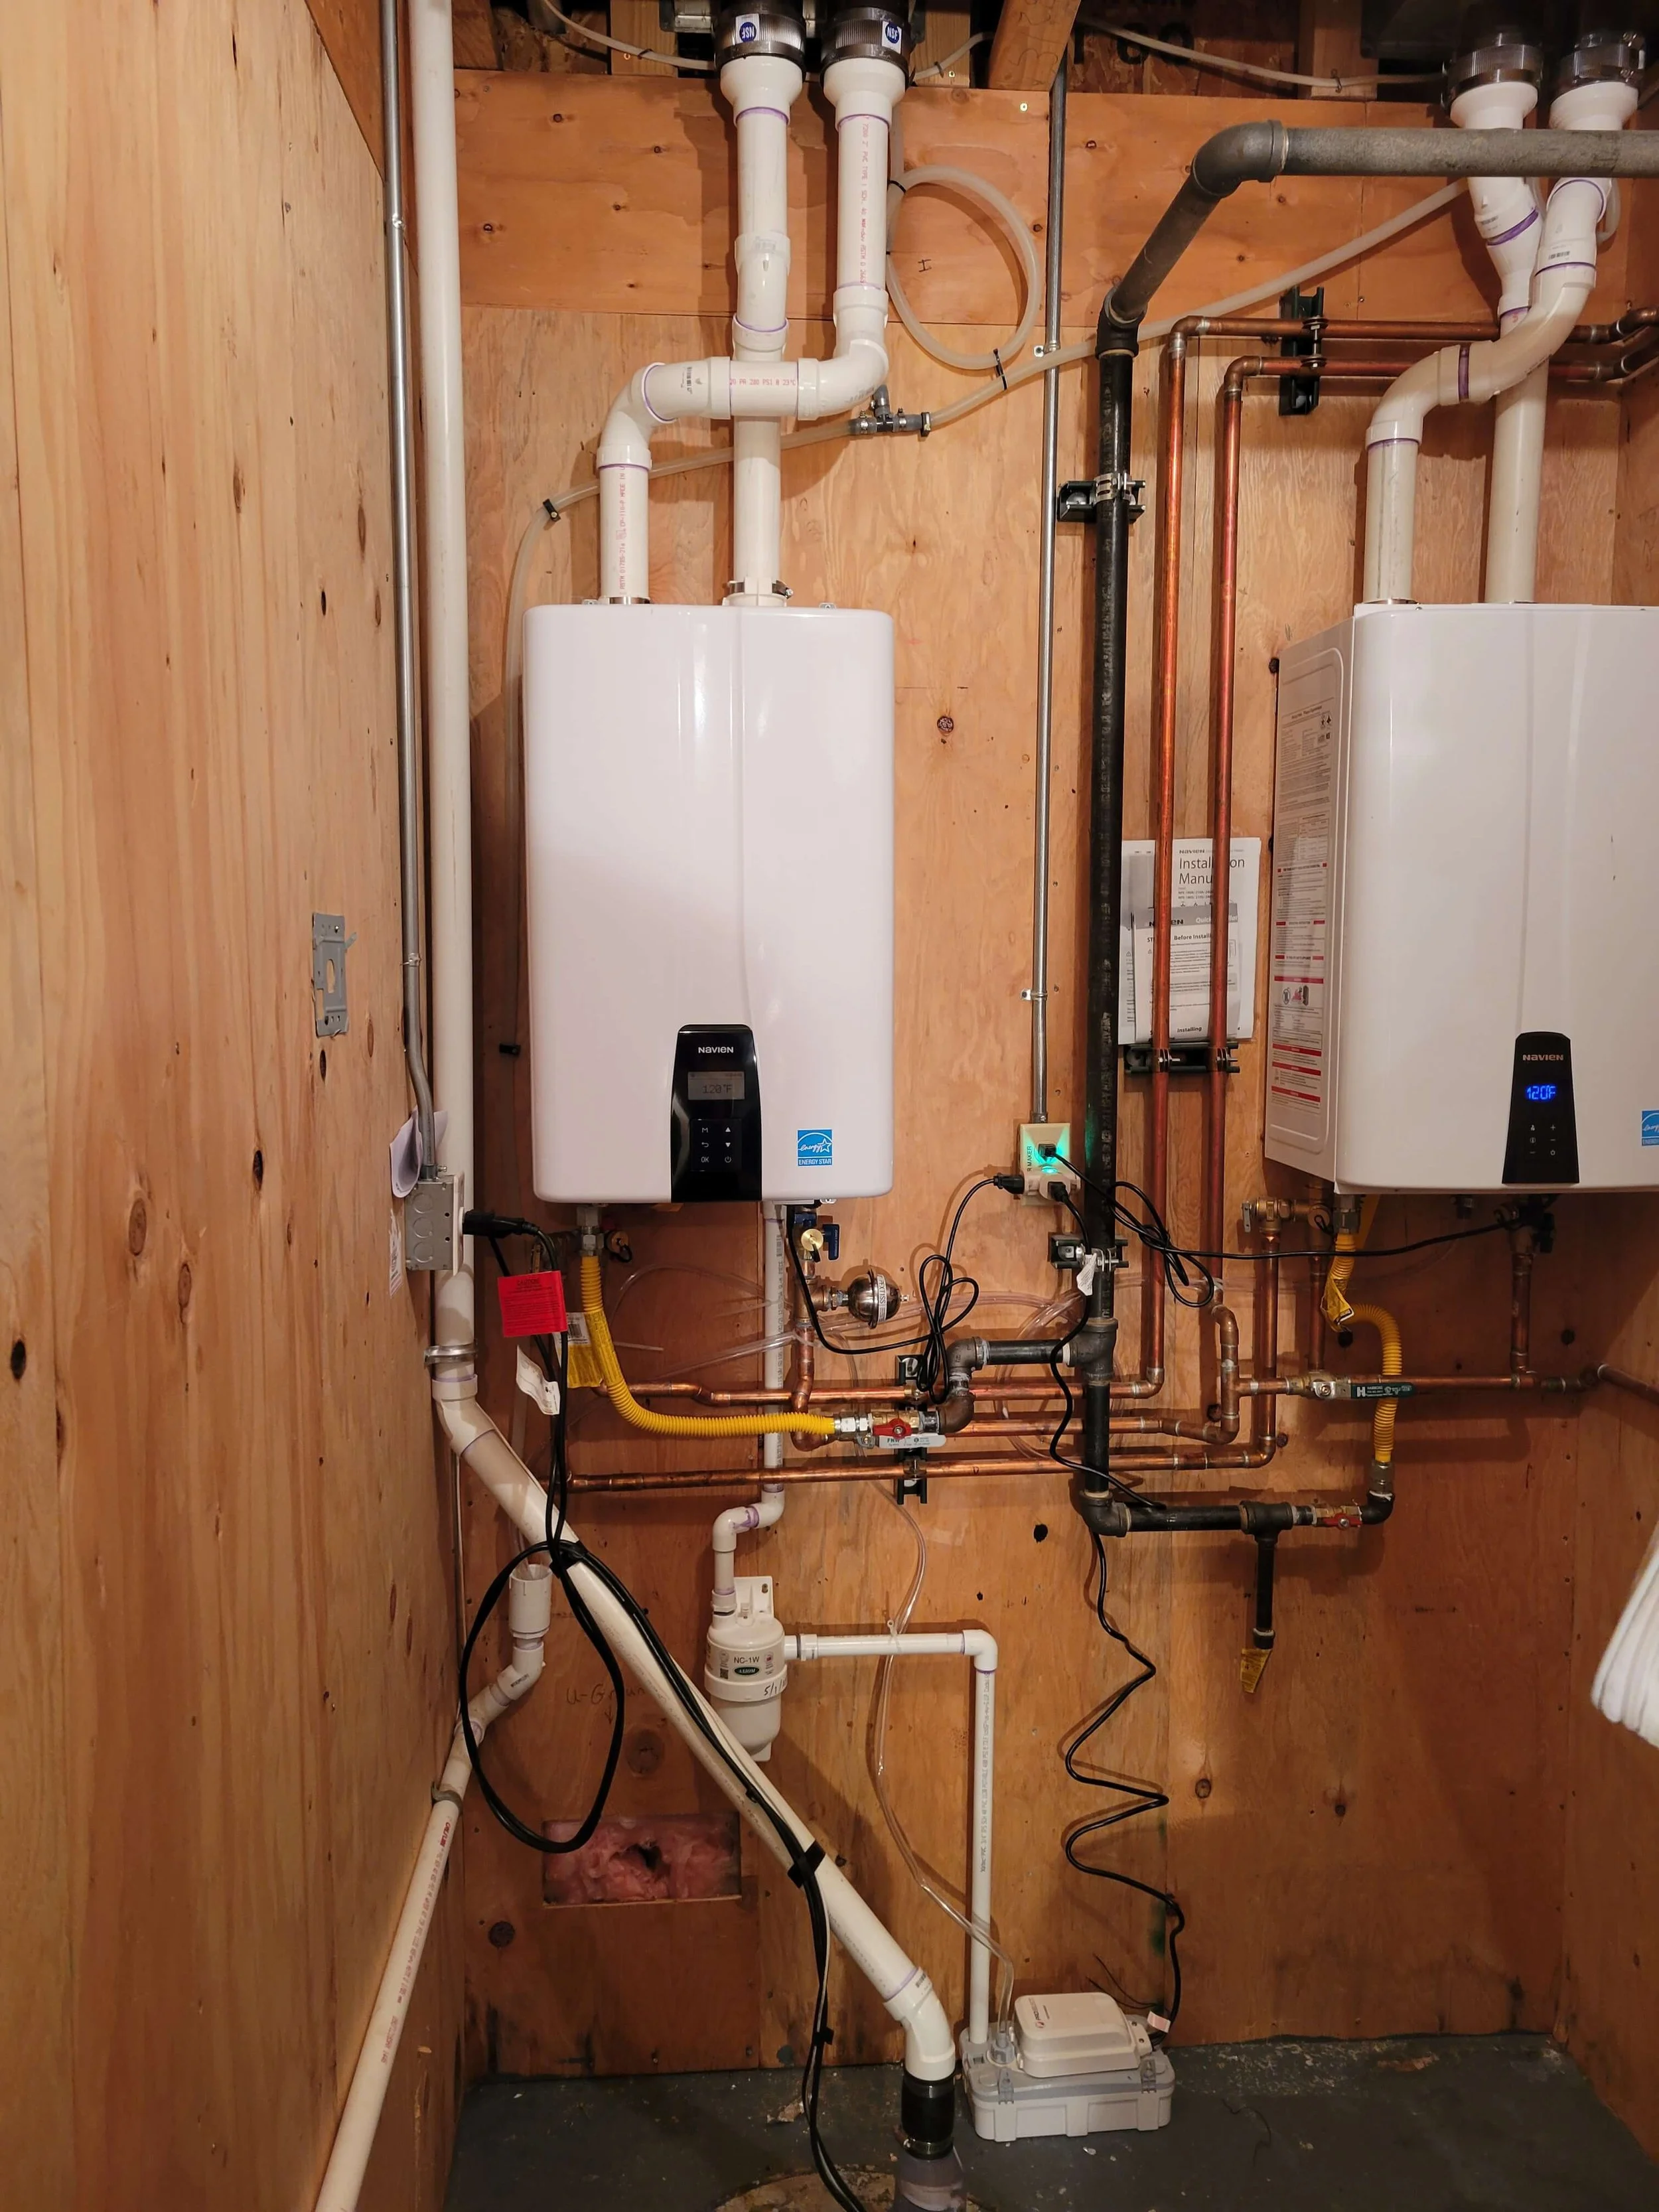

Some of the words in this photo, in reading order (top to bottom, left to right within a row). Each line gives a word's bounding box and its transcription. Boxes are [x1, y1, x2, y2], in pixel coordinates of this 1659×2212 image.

[742, 26, 755, 38] NSF
[887, 27, 898, 38] NSF
[1356, 1386, 1366, 1398] H
